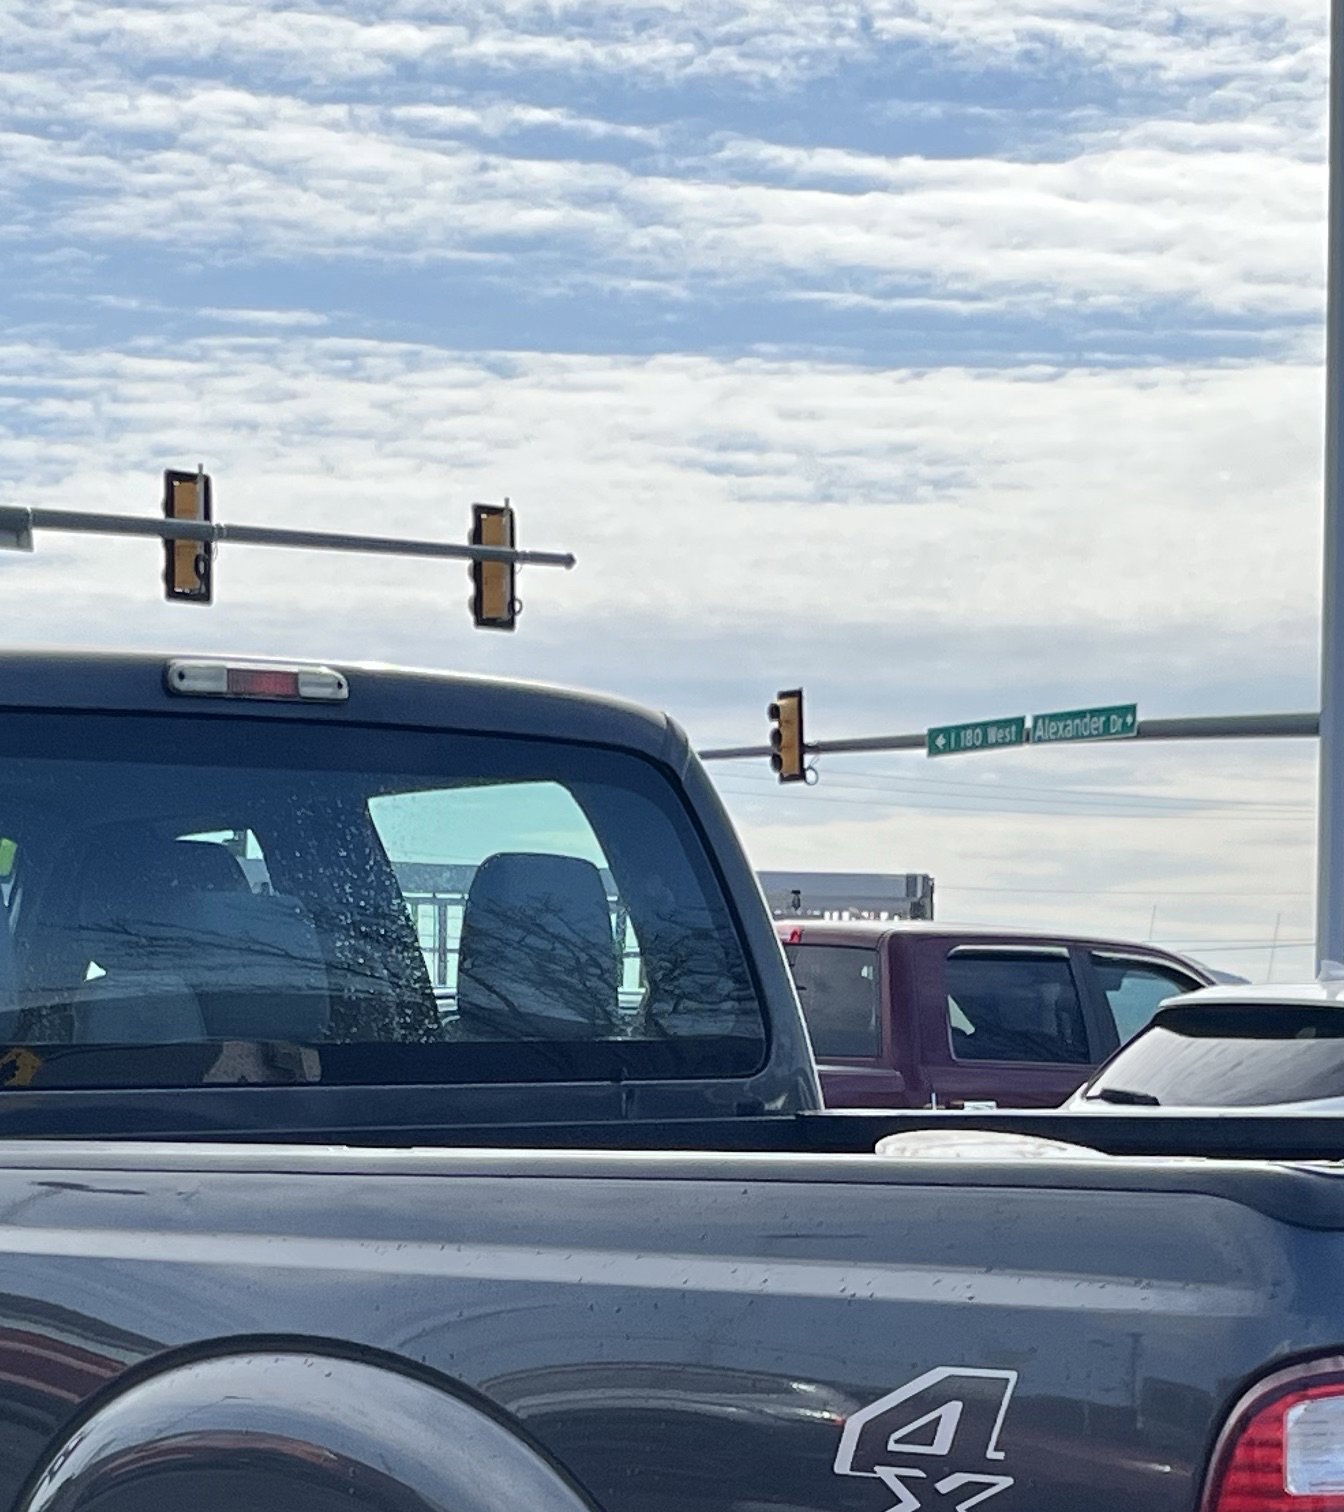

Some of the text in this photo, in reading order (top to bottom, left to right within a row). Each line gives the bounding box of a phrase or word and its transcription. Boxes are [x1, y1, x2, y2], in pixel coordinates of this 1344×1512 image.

[960, 727, 983, 748] 180
[986, 723, 1016, 744] West
[1035, 713, 1123, 740] Alexander Dr
